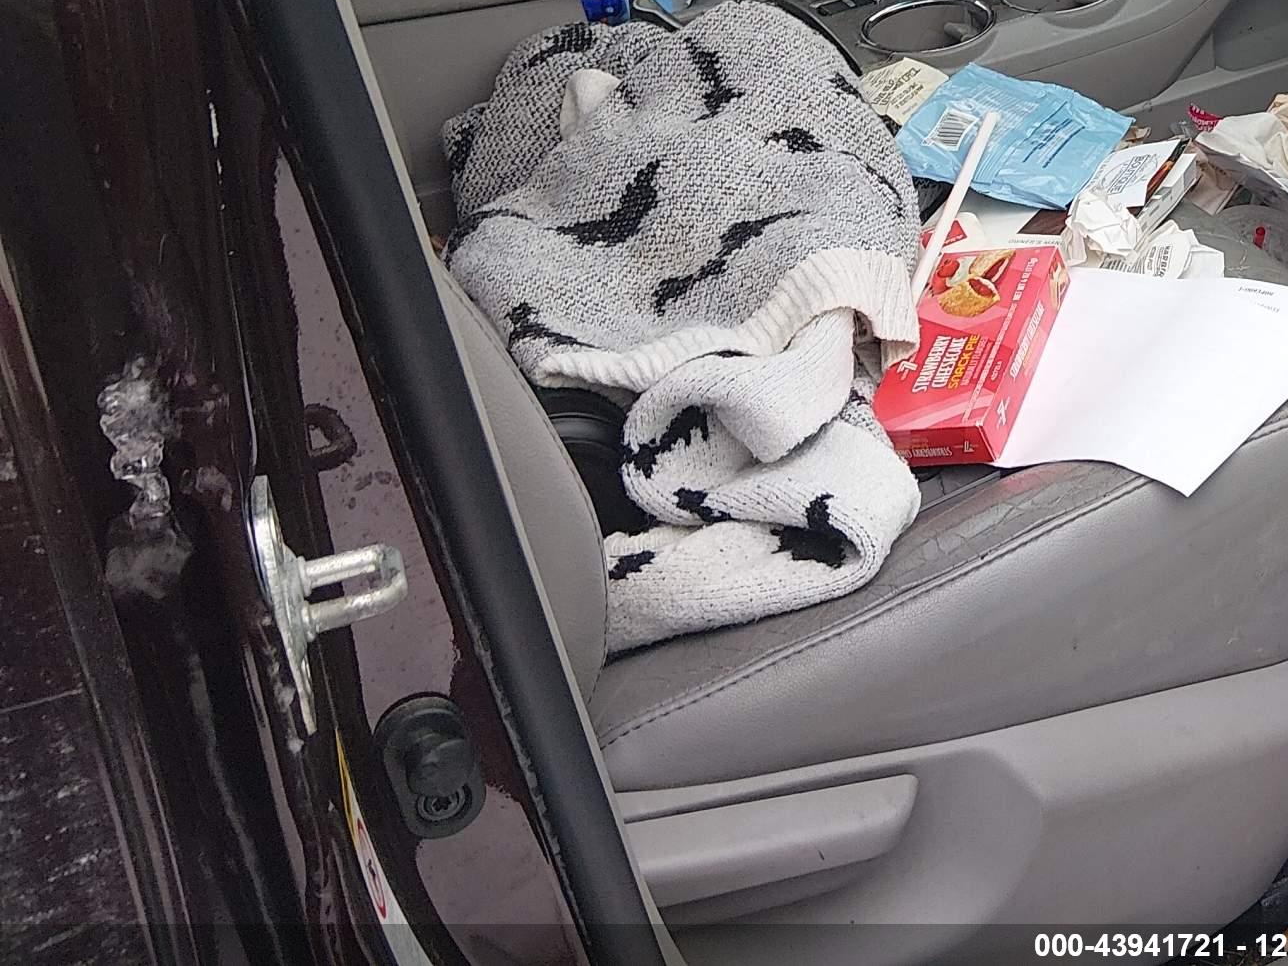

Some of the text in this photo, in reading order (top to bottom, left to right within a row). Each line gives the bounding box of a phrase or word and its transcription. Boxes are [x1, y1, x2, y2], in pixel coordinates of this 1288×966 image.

[912, 335, 951, 393] STRAWBERRY
[932, 336, 968, 388] CHEESECAKE
[948, 333, 981, 389] SNACK PIE
